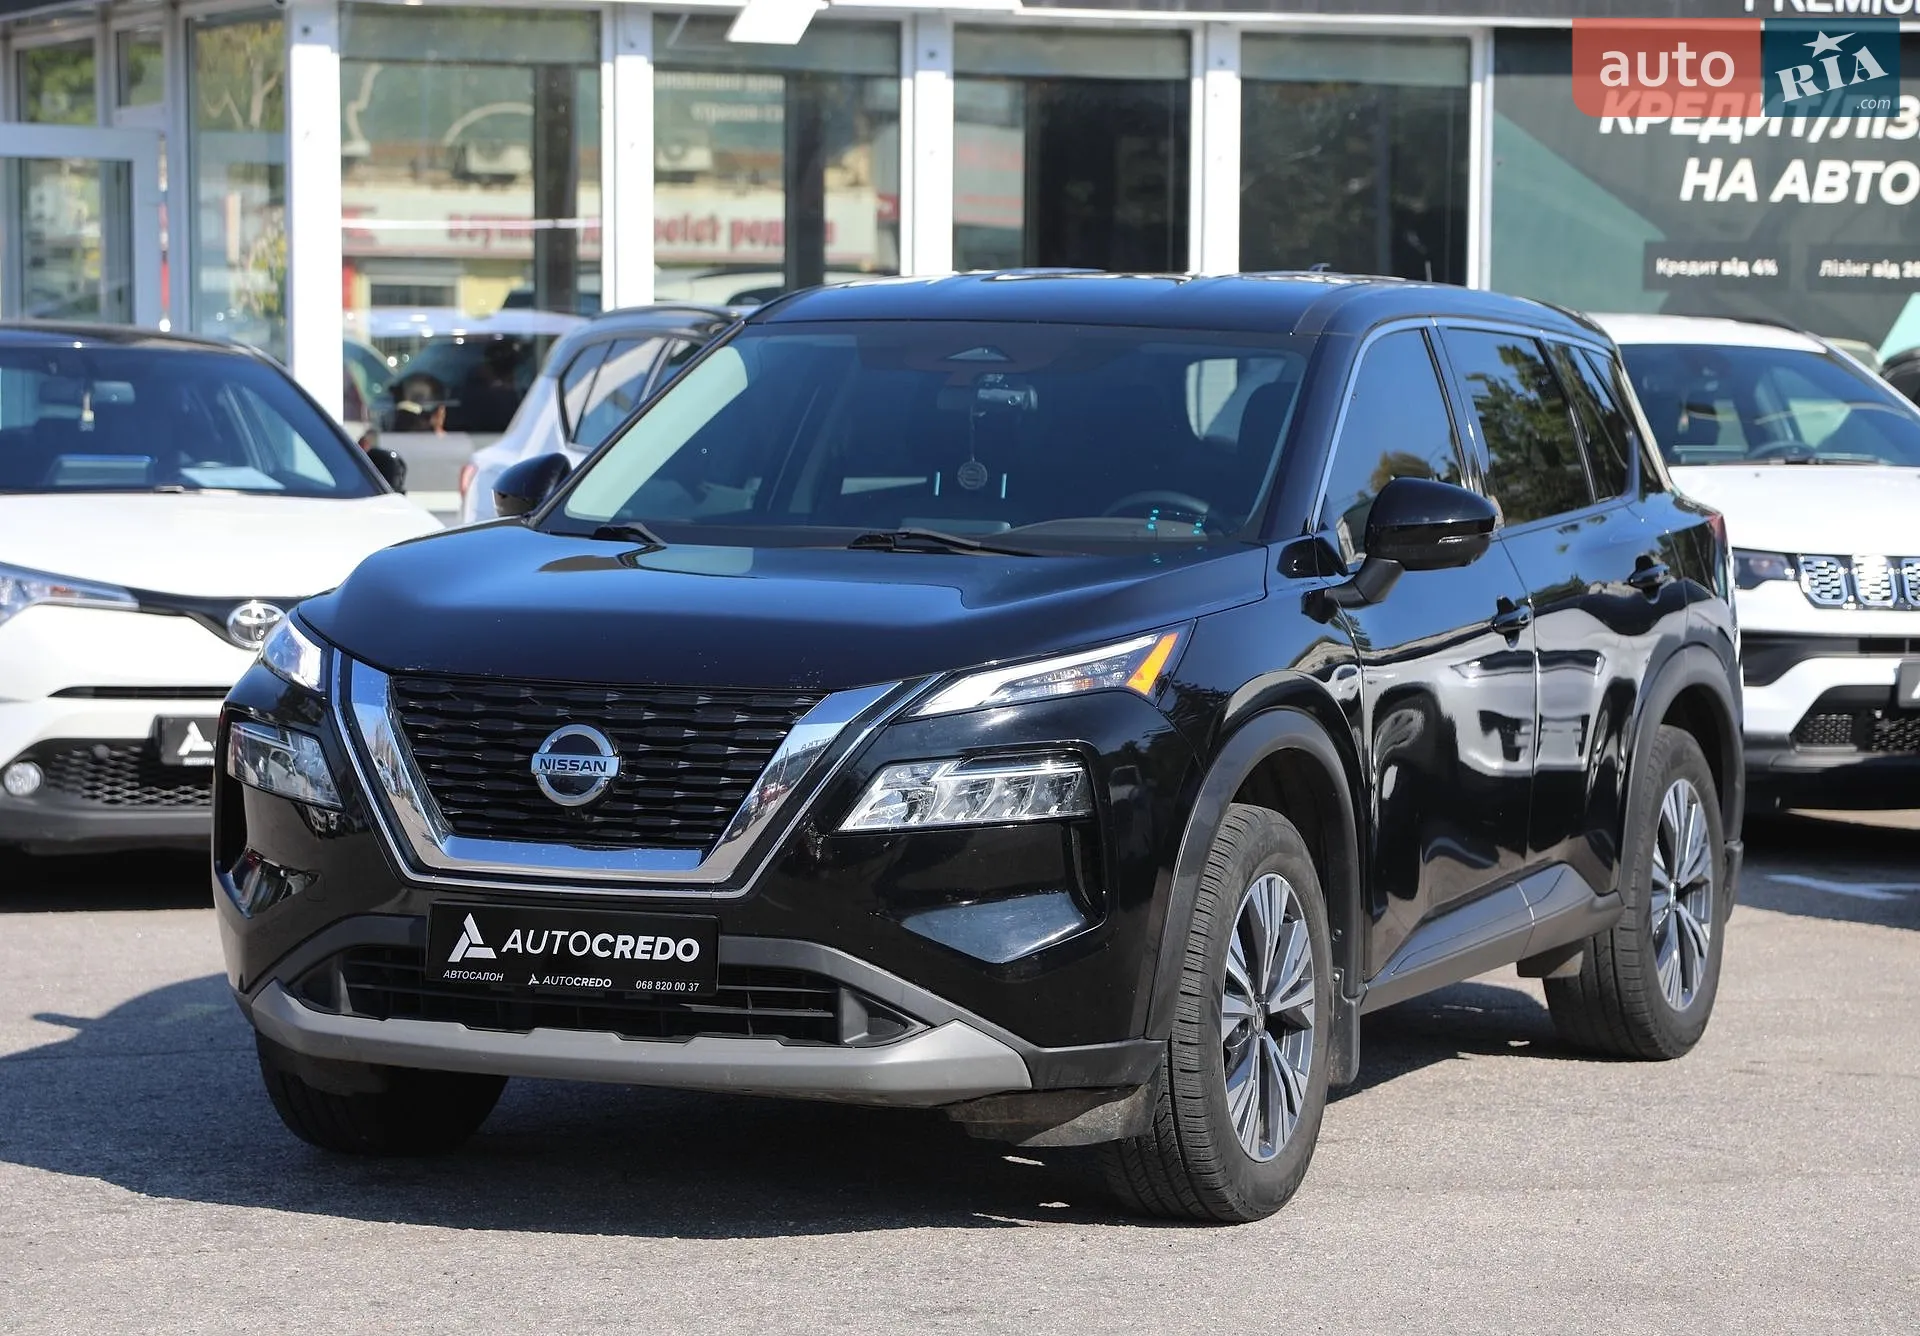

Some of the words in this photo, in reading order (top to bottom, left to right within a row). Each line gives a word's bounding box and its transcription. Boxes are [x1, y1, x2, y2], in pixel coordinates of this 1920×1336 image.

[1599, 90, 1920, 144] КРЕДИТ/ЛІЗ
[1679, 157, 1758, 202] НА
[1769, 158, 1920, 205] АВТО
[1655, 257, 1719, 278] Кредит
[1720, 257, 1750, 278] від
[1819, 259, 1871, 277] Лізінг
[1871, 258, 1901, 279] від
[539, 758, 607, 773] NISSAN
[500, 928, 700, 963] AUTOCREDO
[442, 969, 504, 982] АВТОСАЛОН
[541, 975, 612, 988] AUTOCREDO
[635, 980, 653, 990] 068
[655, 981, 673, 991] 820
[674, 981, 686, 992] 00
[688, 982, 700, 992] 37
